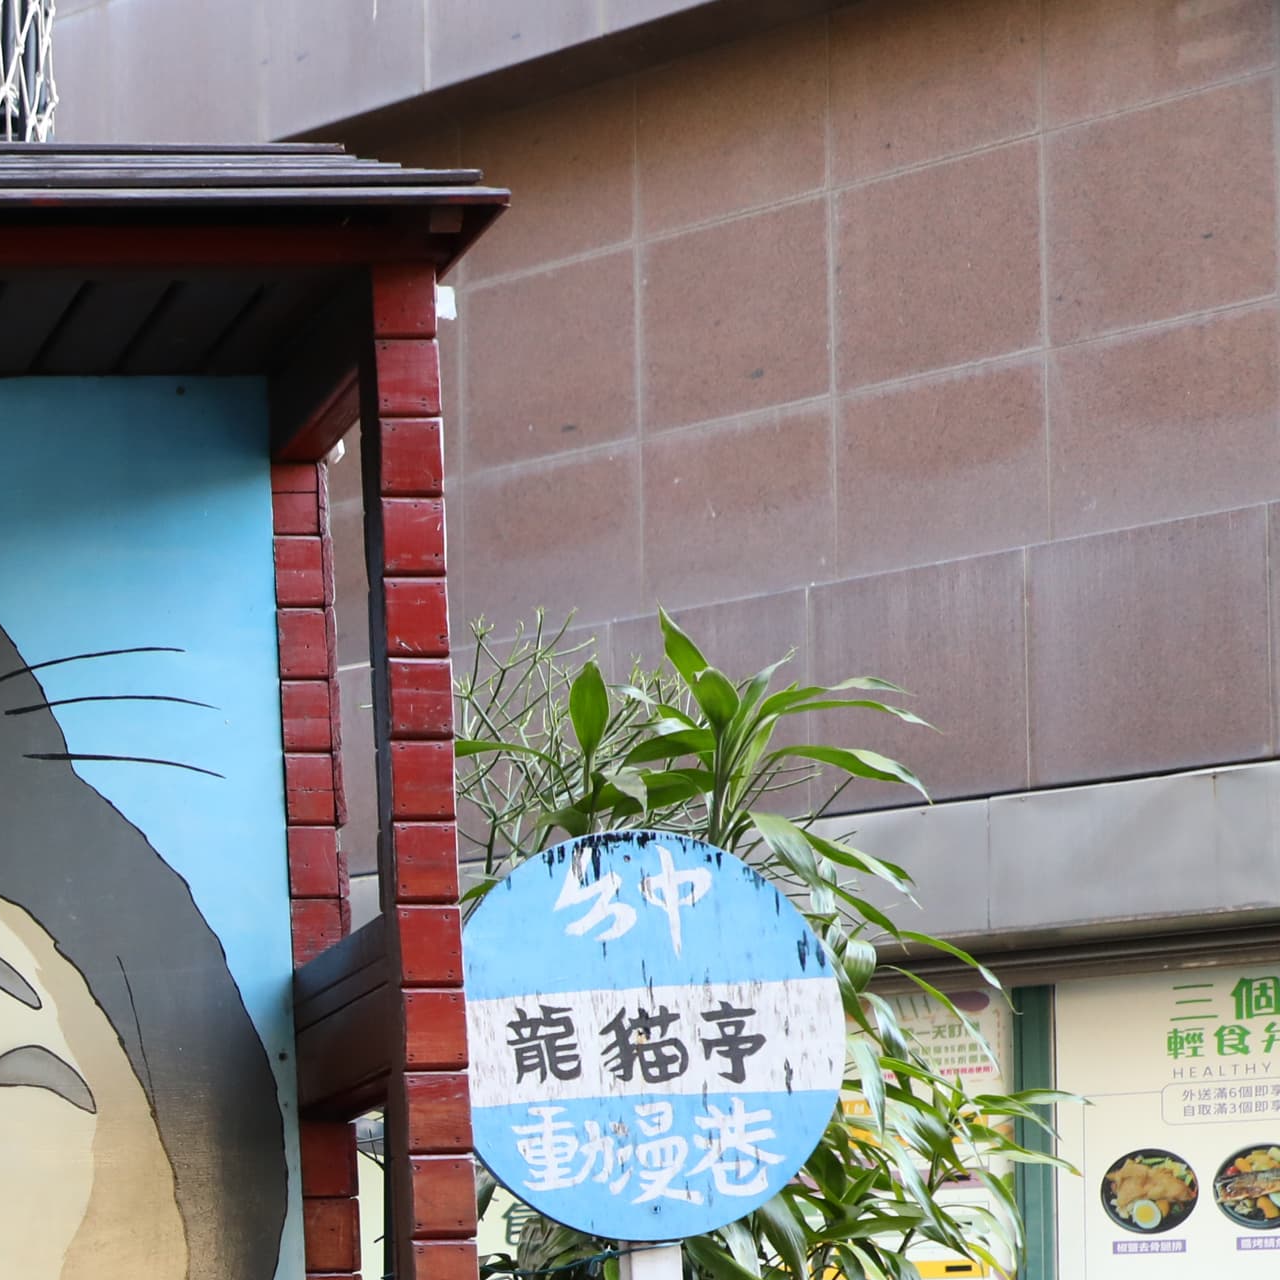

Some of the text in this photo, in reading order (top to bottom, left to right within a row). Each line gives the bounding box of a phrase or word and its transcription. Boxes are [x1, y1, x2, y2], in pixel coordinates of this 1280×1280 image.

[507, 1000, 767, 1085] 龍貓亭
[1173, 1062, 1272, 1079] HEALTHY
[511, 1098, 787, 1205] 動漫巷
